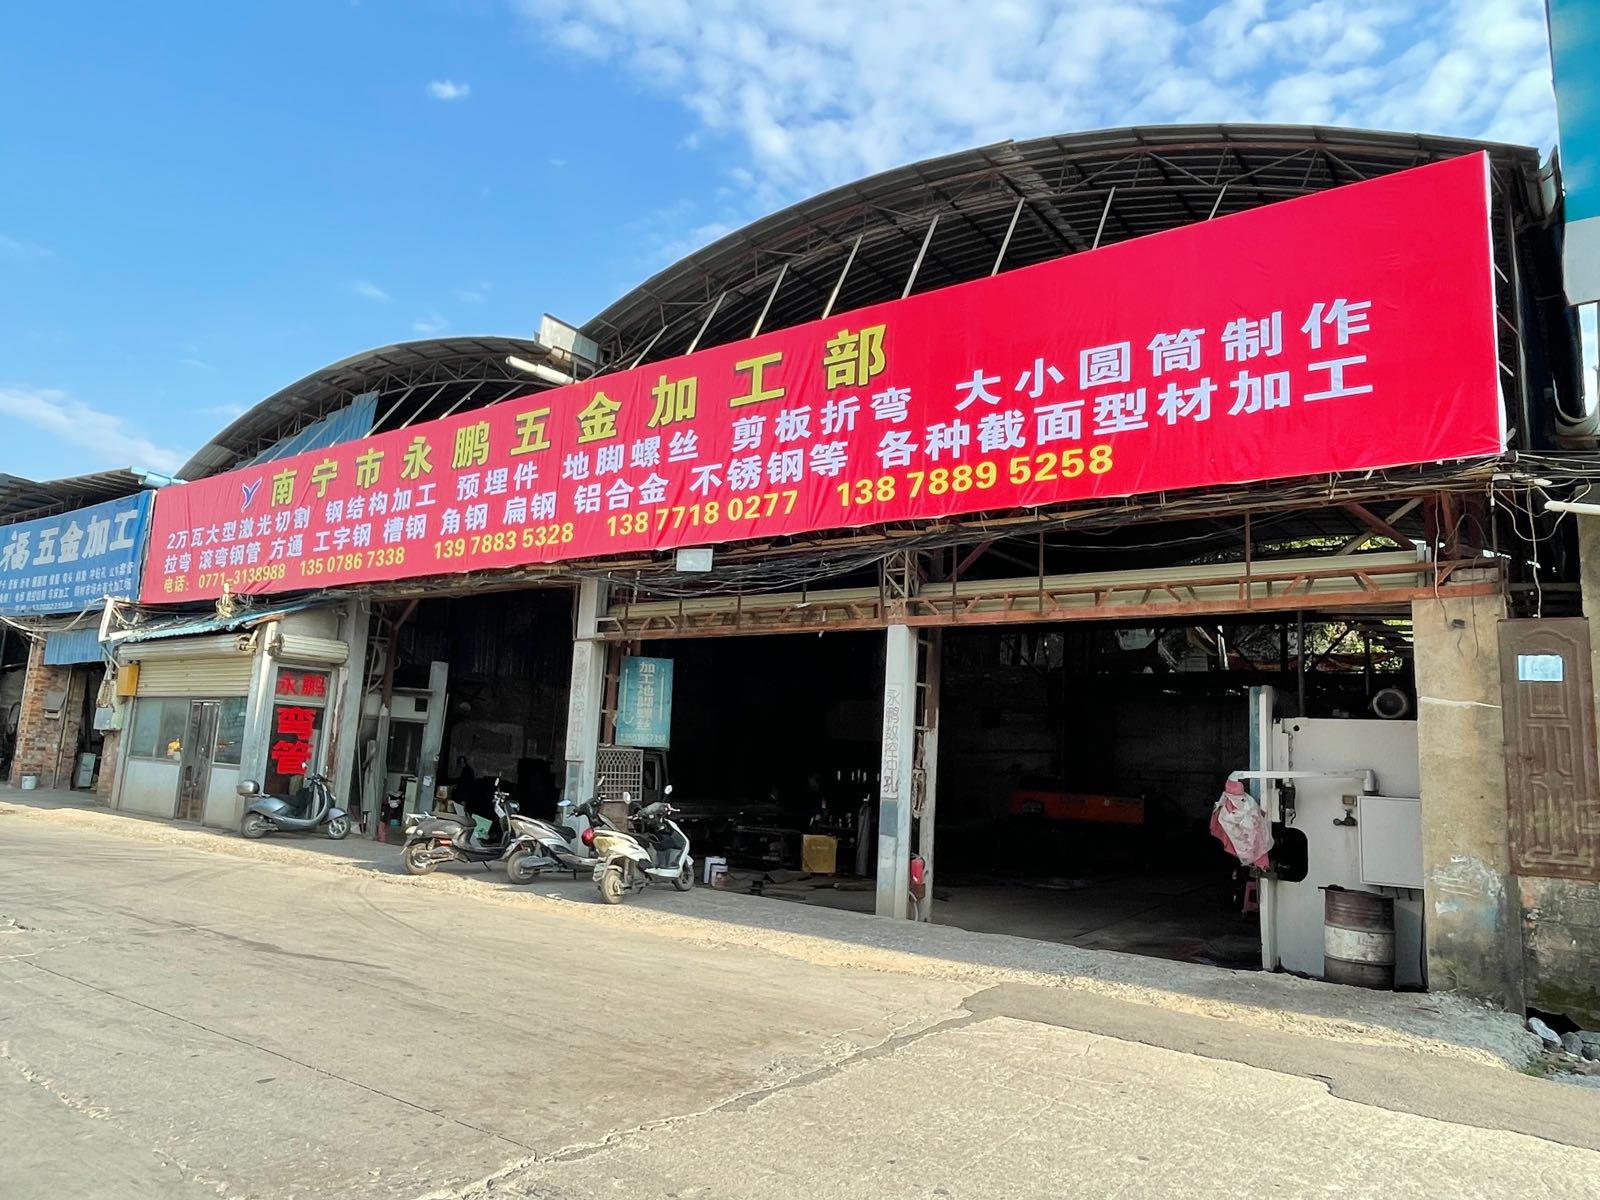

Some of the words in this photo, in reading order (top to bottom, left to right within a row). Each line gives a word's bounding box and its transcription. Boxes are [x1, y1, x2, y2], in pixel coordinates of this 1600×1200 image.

[163, 551, 191, 574] 拉弯
[199, 541, 261, 570] 滚弯钢管
[270, 534, 303, 561] 方通
[313, 523, 371, 552] 工字钢
[383, 514, 427, 544] 槽钢
[440, 503, 488, 536] 角钢
[503, 491, 556, 525] 扁钢
[574, 473, 669, 514] 铝合金
[689, 441, 848, 496] 不锈钢等
[876, 355, 1372, 469] 各种截面型材加工
[166, 506, 311, 549] 2万瓦大型激光切割
[325, 483, 436, 524] 钢结构加工
[457, 461, 538, 501] 预埋件
[562, 430, 698, 480] 地脚螺丝
[732, 387, 911, 452] 剪板折弯
[955, 299, 1371, 411] 大小圆筒制作
[272, 324, 886, 506] 南宁市永鹏五金加工部
[199, 563, 286, 589] 0771-3138988
[301, 558, 325, 576] 135
[328, 553, 363, 574] 0786
[368, 546, 406, 566] 7338
[434, 537, 466, 559] 139
[473, 530, 516, 552] 7883
[522, 522, 573, 548] 5328
[608, 512, 648, 536] 138
[657, 501, 719, 529] 7718
[727, 490, 797, 520] 0277
[838, 476, 895, 506] 138
[907, 461, 996, 497] 7889
[1010, 445, 1113, 484] 5258
[276, 671, 327, 697] 永鹏
